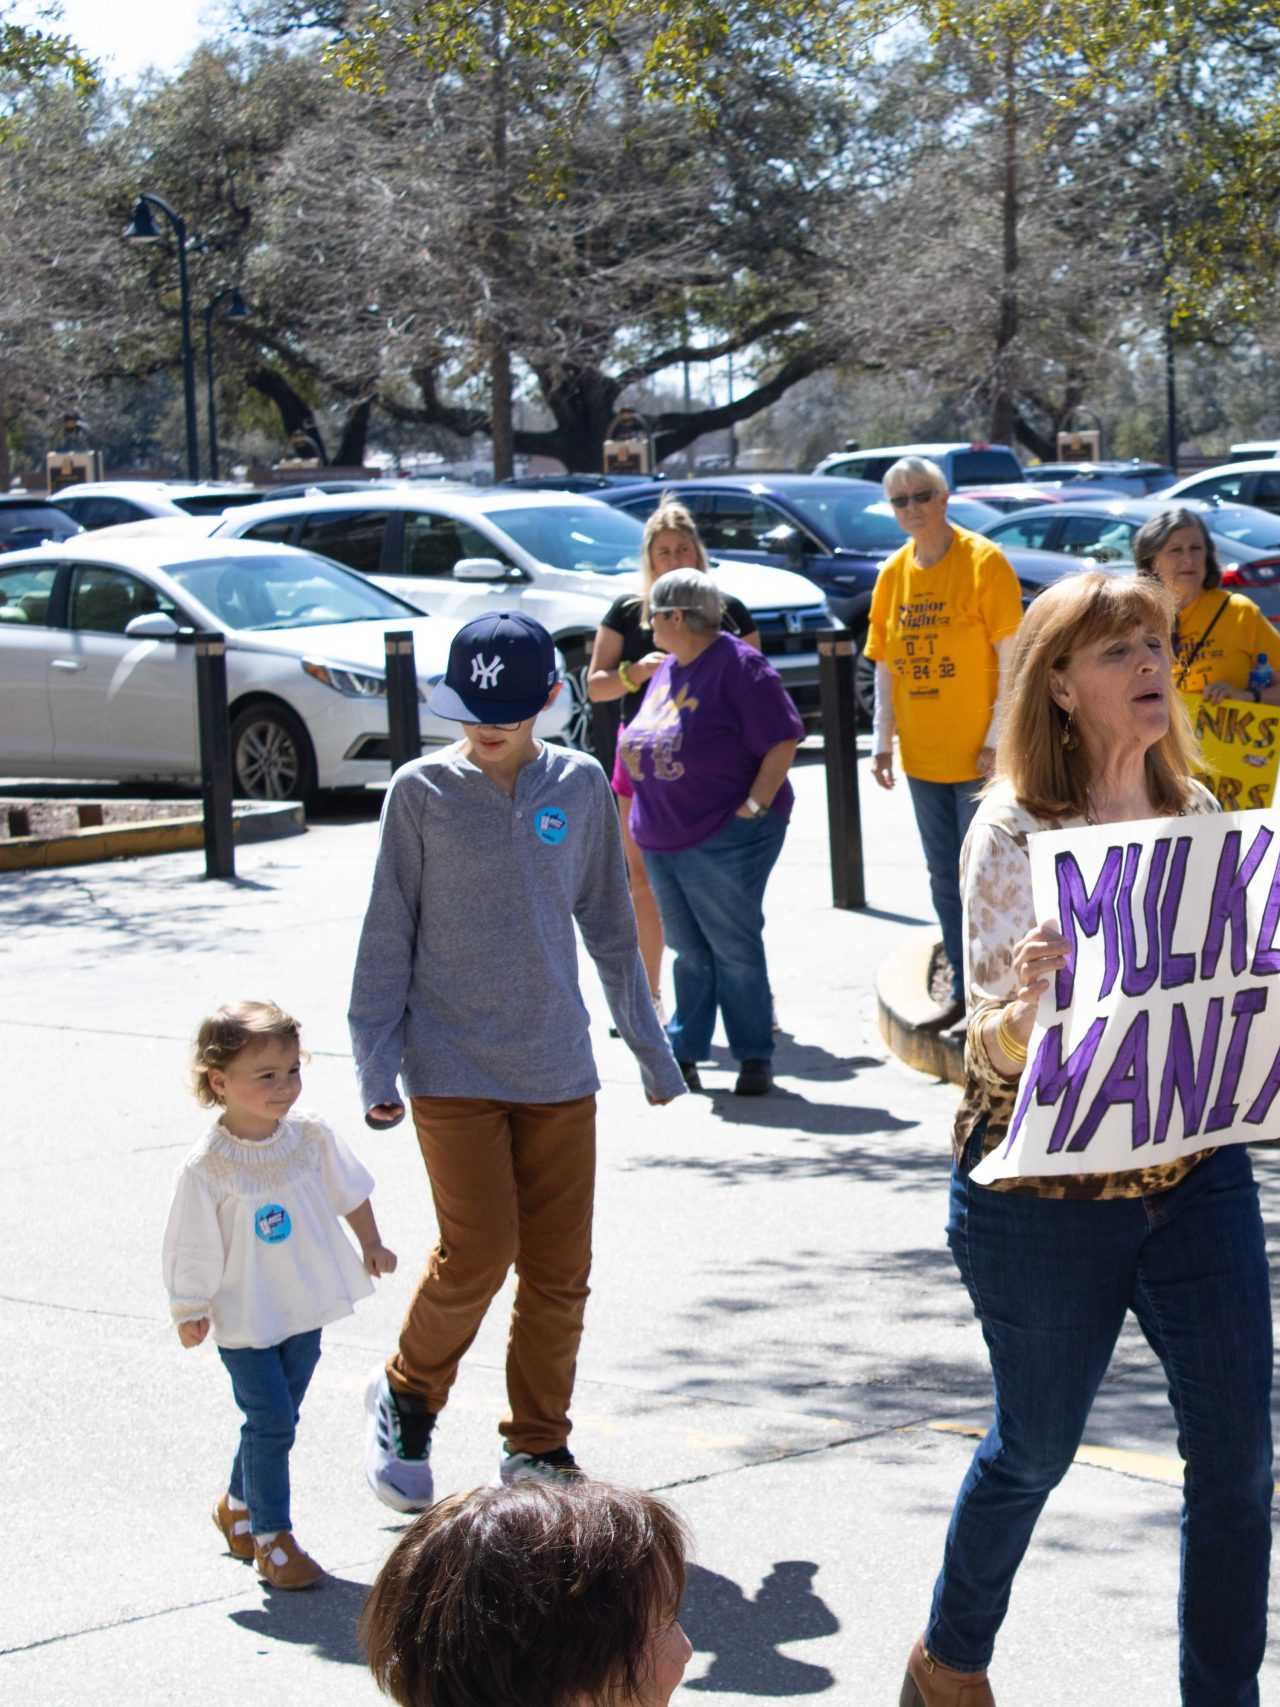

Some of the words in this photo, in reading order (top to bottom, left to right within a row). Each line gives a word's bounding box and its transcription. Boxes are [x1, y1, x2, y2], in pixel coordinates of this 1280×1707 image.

[470, 652, 505, 690] NY
[913, 664, 930, 679] 24
[938, 663, 956, 678] 32
